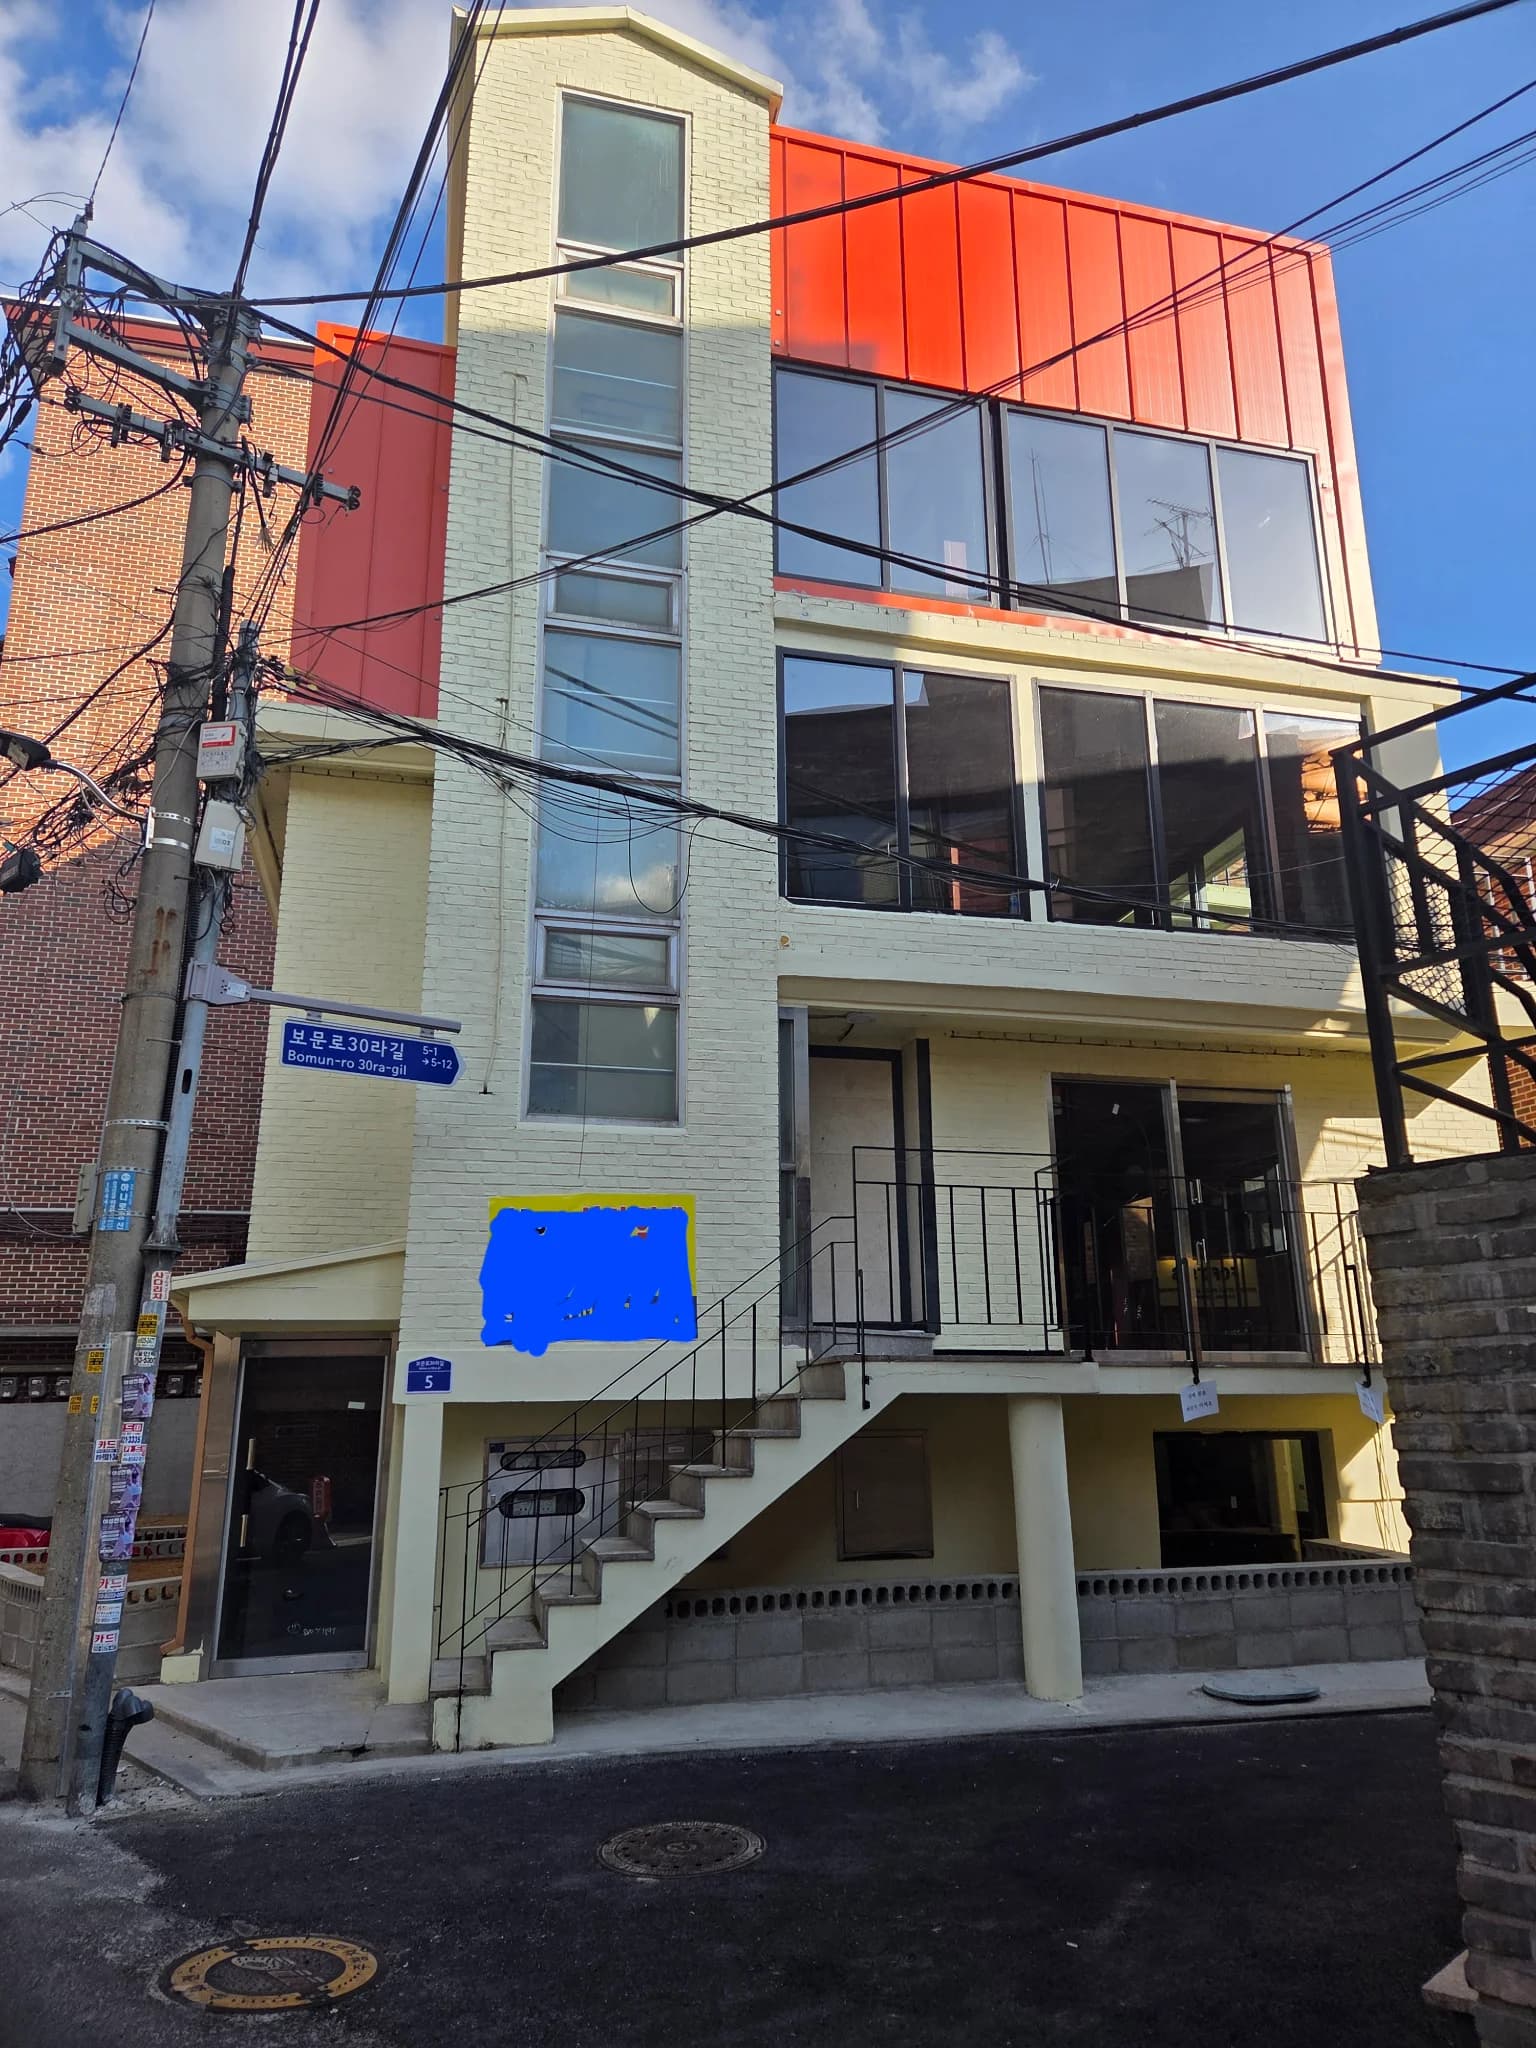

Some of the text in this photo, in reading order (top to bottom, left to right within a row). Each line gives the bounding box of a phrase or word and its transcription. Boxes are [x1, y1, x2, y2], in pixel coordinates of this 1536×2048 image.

[289, 1028, 405, 1061] 보문로30라길
[422, 1045, 438, 1057] 5-1
[287, 1050, 407, 1077] Bomun-ro 30ra-gil
[431, 1058, 453, 1070] 5-12
[424, 1375, 434, 1389] 5
[95, 1633, 114, 1643] 카드
